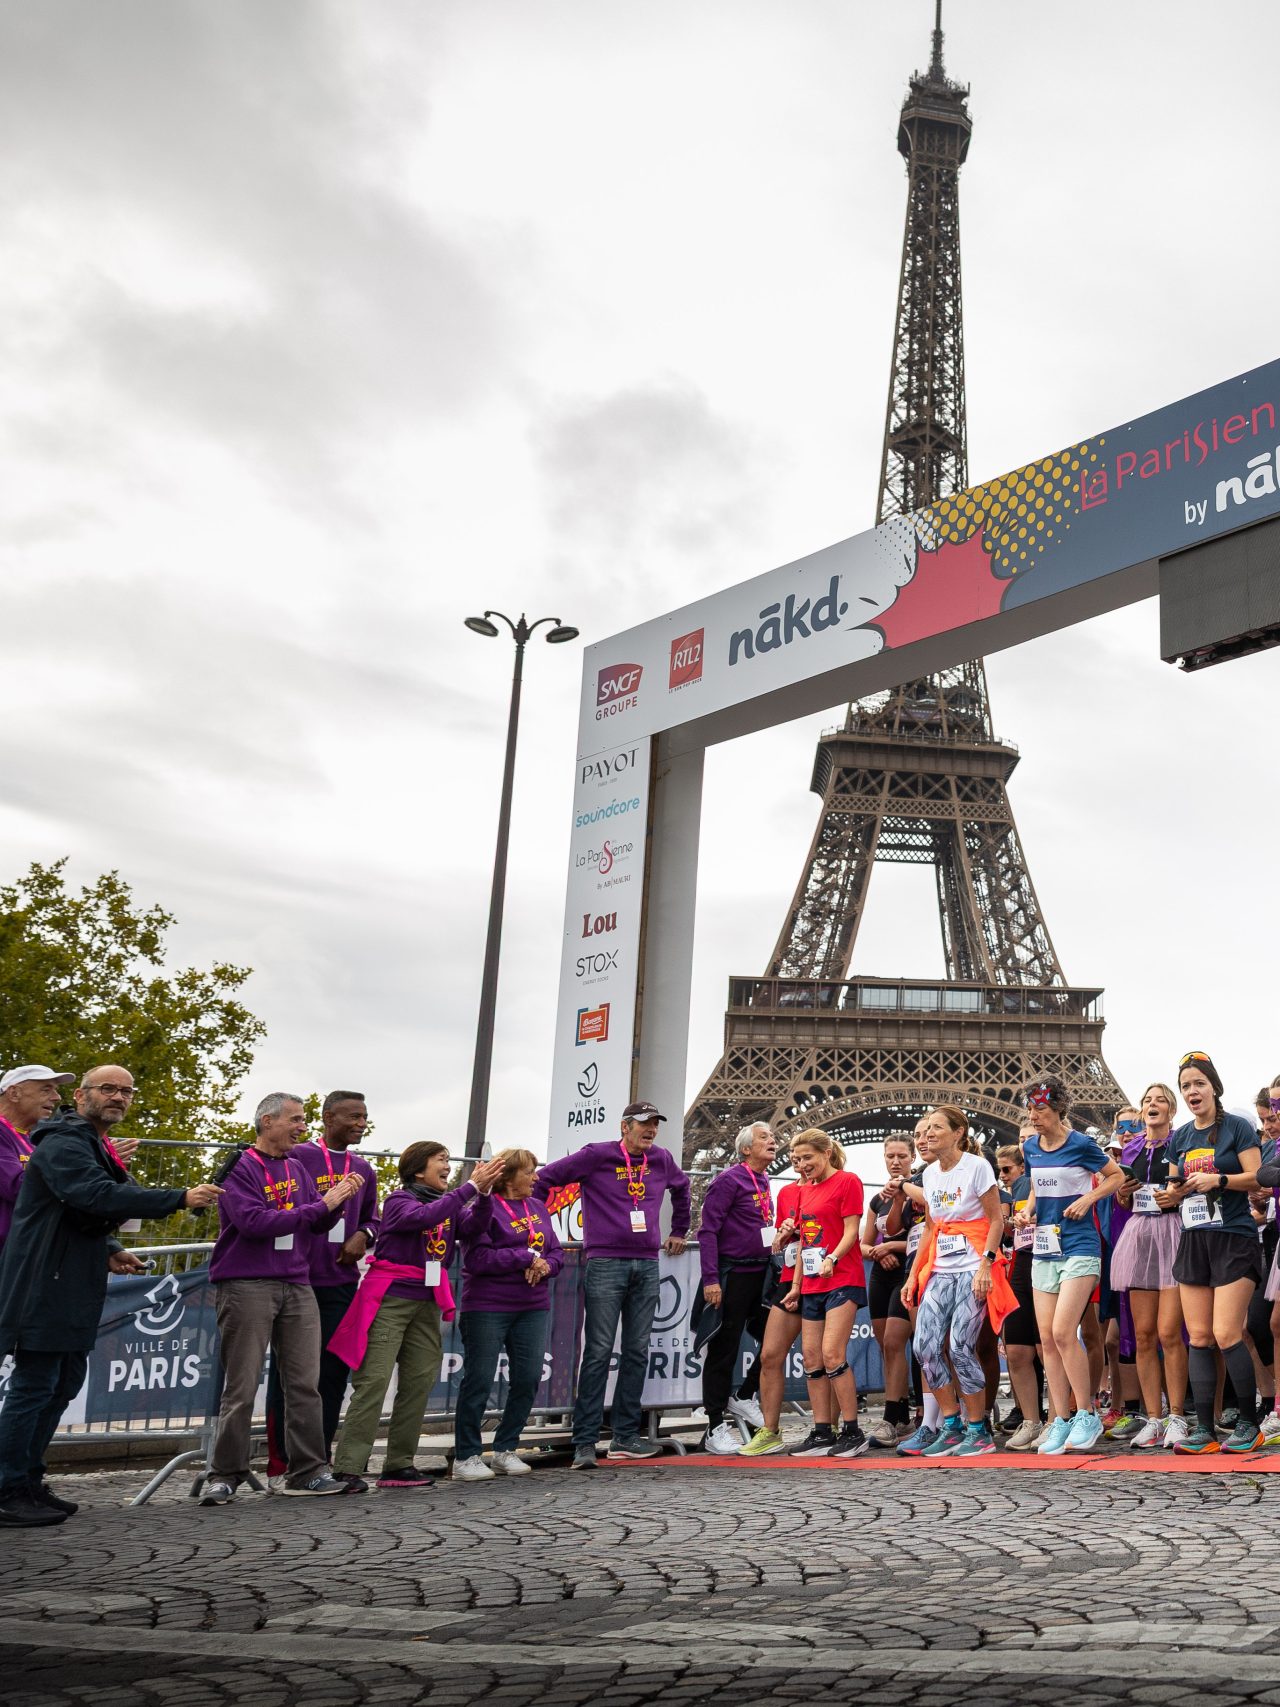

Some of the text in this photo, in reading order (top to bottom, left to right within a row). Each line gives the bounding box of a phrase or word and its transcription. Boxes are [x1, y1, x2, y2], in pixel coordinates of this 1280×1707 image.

[1184, 499, 1208, 526] by
[673, 644, 701, 671] RTL2
[599, 669, 640, 700] SNCF
[595, 696, 638, 720] GROUPE
[582, 747, 640, 784] PAYOT
[576, 797, 640, 828] soundcore
[582, 912, 617, 938] Lou
[576, 949, 619, 977] STOX
[574, 1098, 601, 1108] VILLE DE
[568, 1107, 605, 1127] PARIS
[1037, 1179, 1058, 1187] Cécile
[125, 1339, 189, 1354] VILLE DE
[108, 1354, 201, 1392] PARIS
